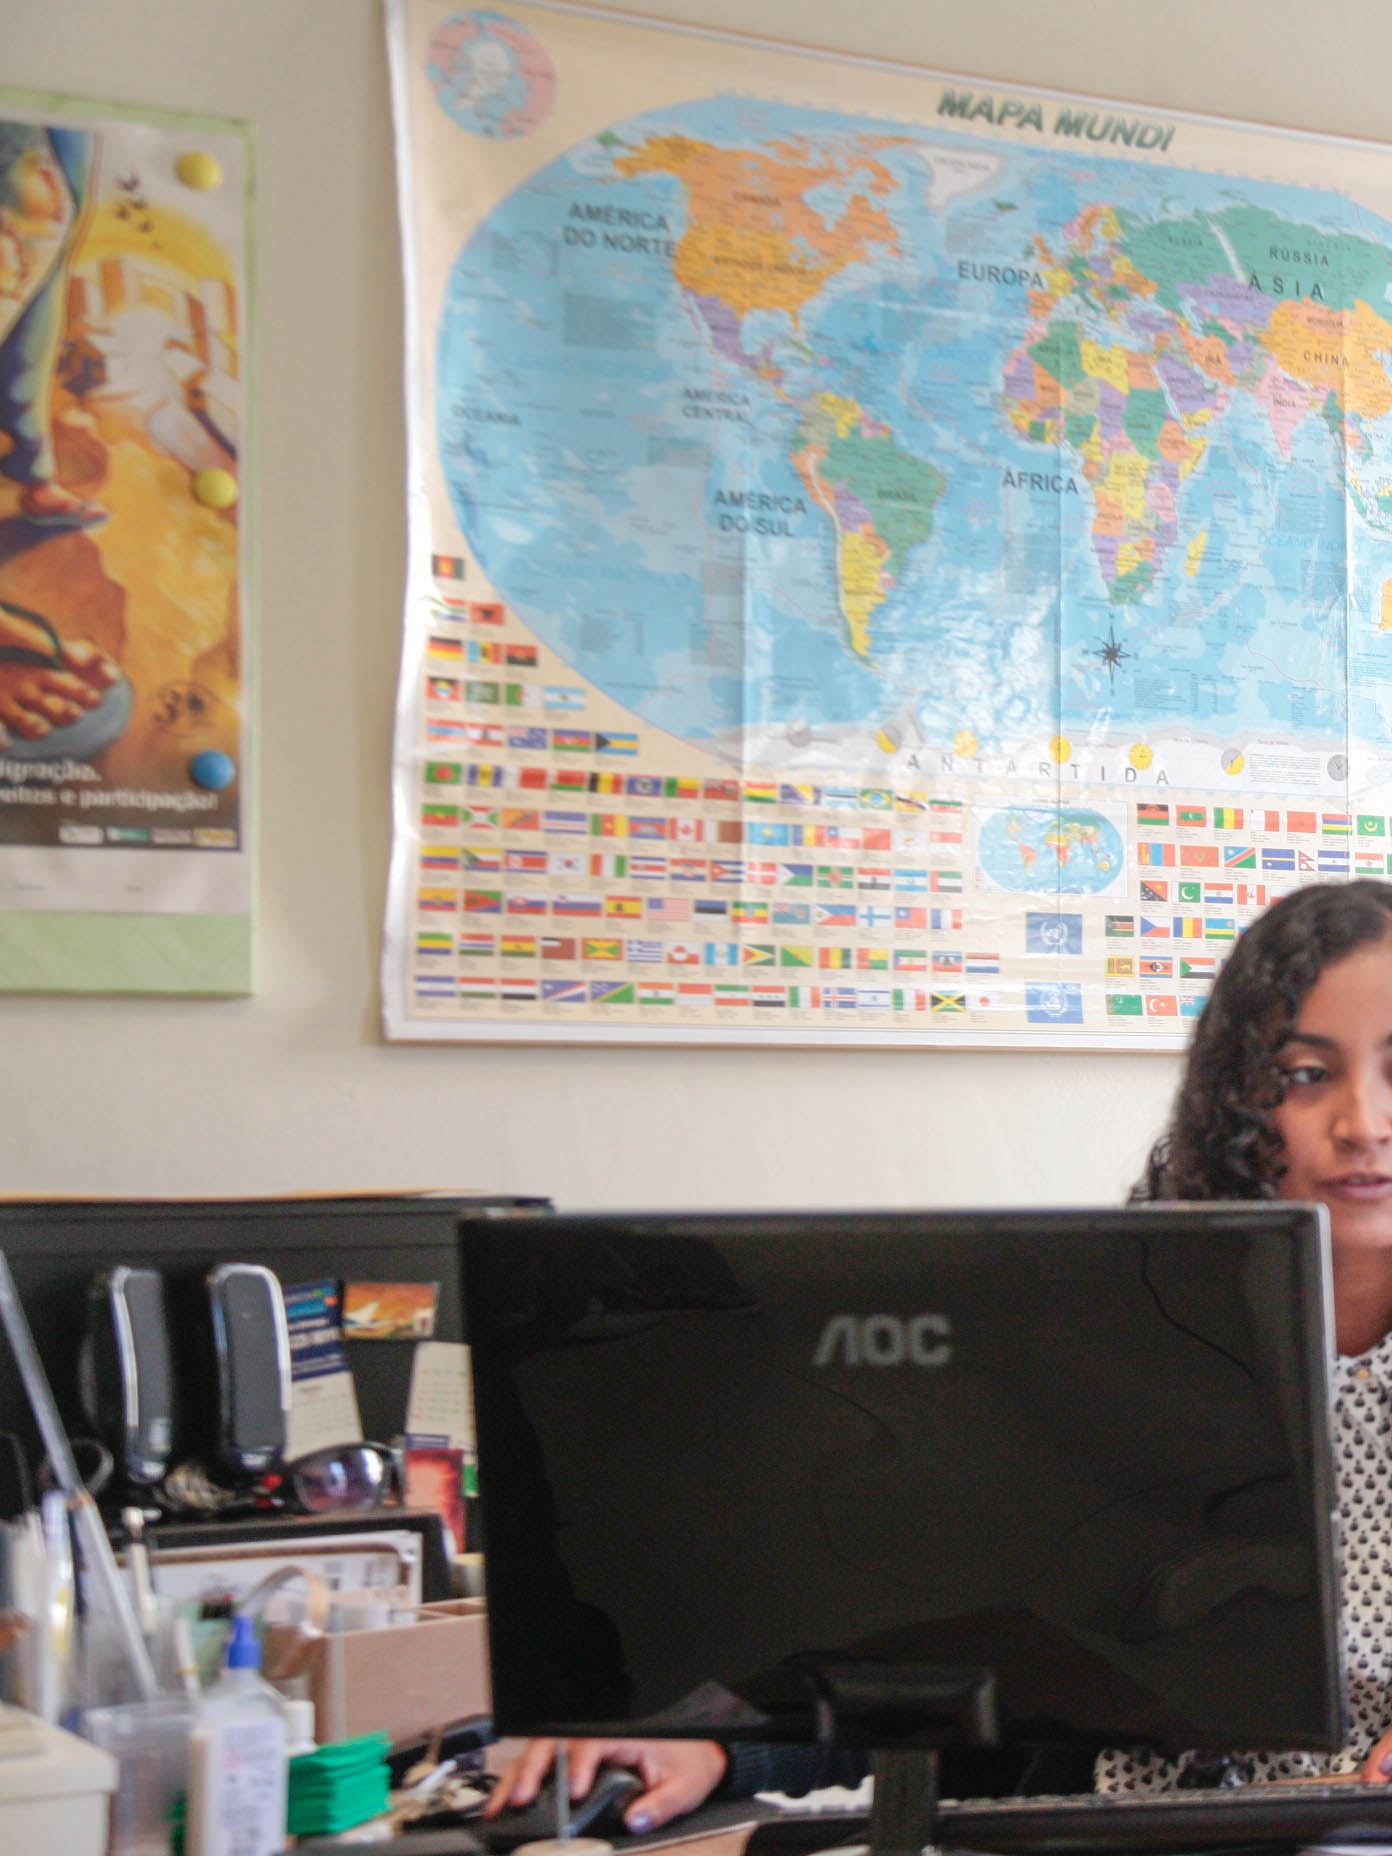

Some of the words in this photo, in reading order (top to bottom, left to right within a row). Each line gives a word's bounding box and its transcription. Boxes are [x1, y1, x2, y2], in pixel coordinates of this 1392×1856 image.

[937, 89, 1044, 133] MAPA
[1053, 107, 1176, 152] MUNDI
[562, 225, 597, 247] DO
[603, 231, 677, 259] NORTE
[957, 259, 1046, 290] EUROPA
[1303, 350, 1350, 367] CHINA
[718, 514, 748, 534] DO
[756, 517, 796, 538] SUL
